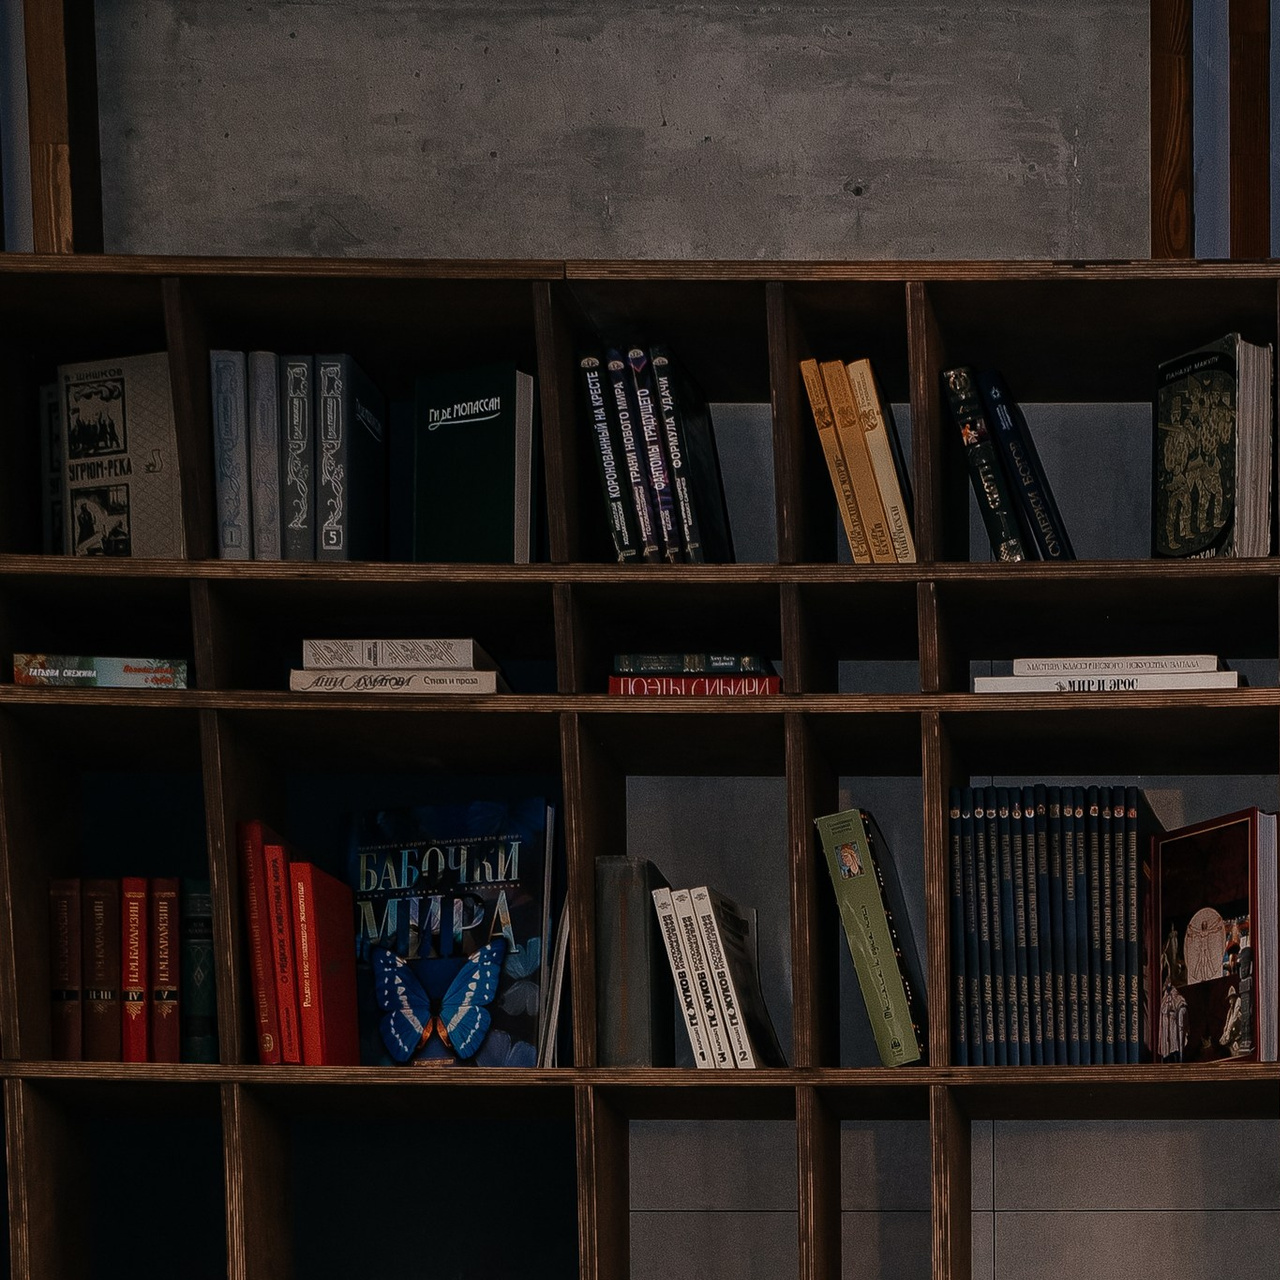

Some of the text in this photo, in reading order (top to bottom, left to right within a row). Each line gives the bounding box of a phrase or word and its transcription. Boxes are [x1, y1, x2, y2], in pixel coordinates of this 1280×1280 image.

[76, 367, 123, 381] ШИШКОВ
[587, 371, 620, 498] КОРОНОВАННЫЙ НА КРЕСТЕ
[614, 381, 641, 482] ГРАНИ НОВОГО МИРА
[637, 389, 666, 490] ФАНТОМЫ ГРЯДУЩЕГО
[659, 376, 682, 468] ФОРМУЛА УДАЧИ
[68, 456, 133, 482] УГРЮМ-РЕКА
[328, 531, 338, 544] 5
[424, 677, 447, 685] Стихи
[456, 678, 478, 686] проза
[621, 677, 685, 695] ПОЭТЫ
[1068, 679, 1094, 691] МИР
[1110, 678, 1138, 691] ЭРОС
[357, 841, 522, 892] БАБОЧКИ
[357, 890, 520, 959] МИРА
[678, 971, 695, 1011] ЖУКОВ
[697, 972, 714, 1011] ЖУКОВ
[717, 971, 734, 1010] ЖУКОВ
